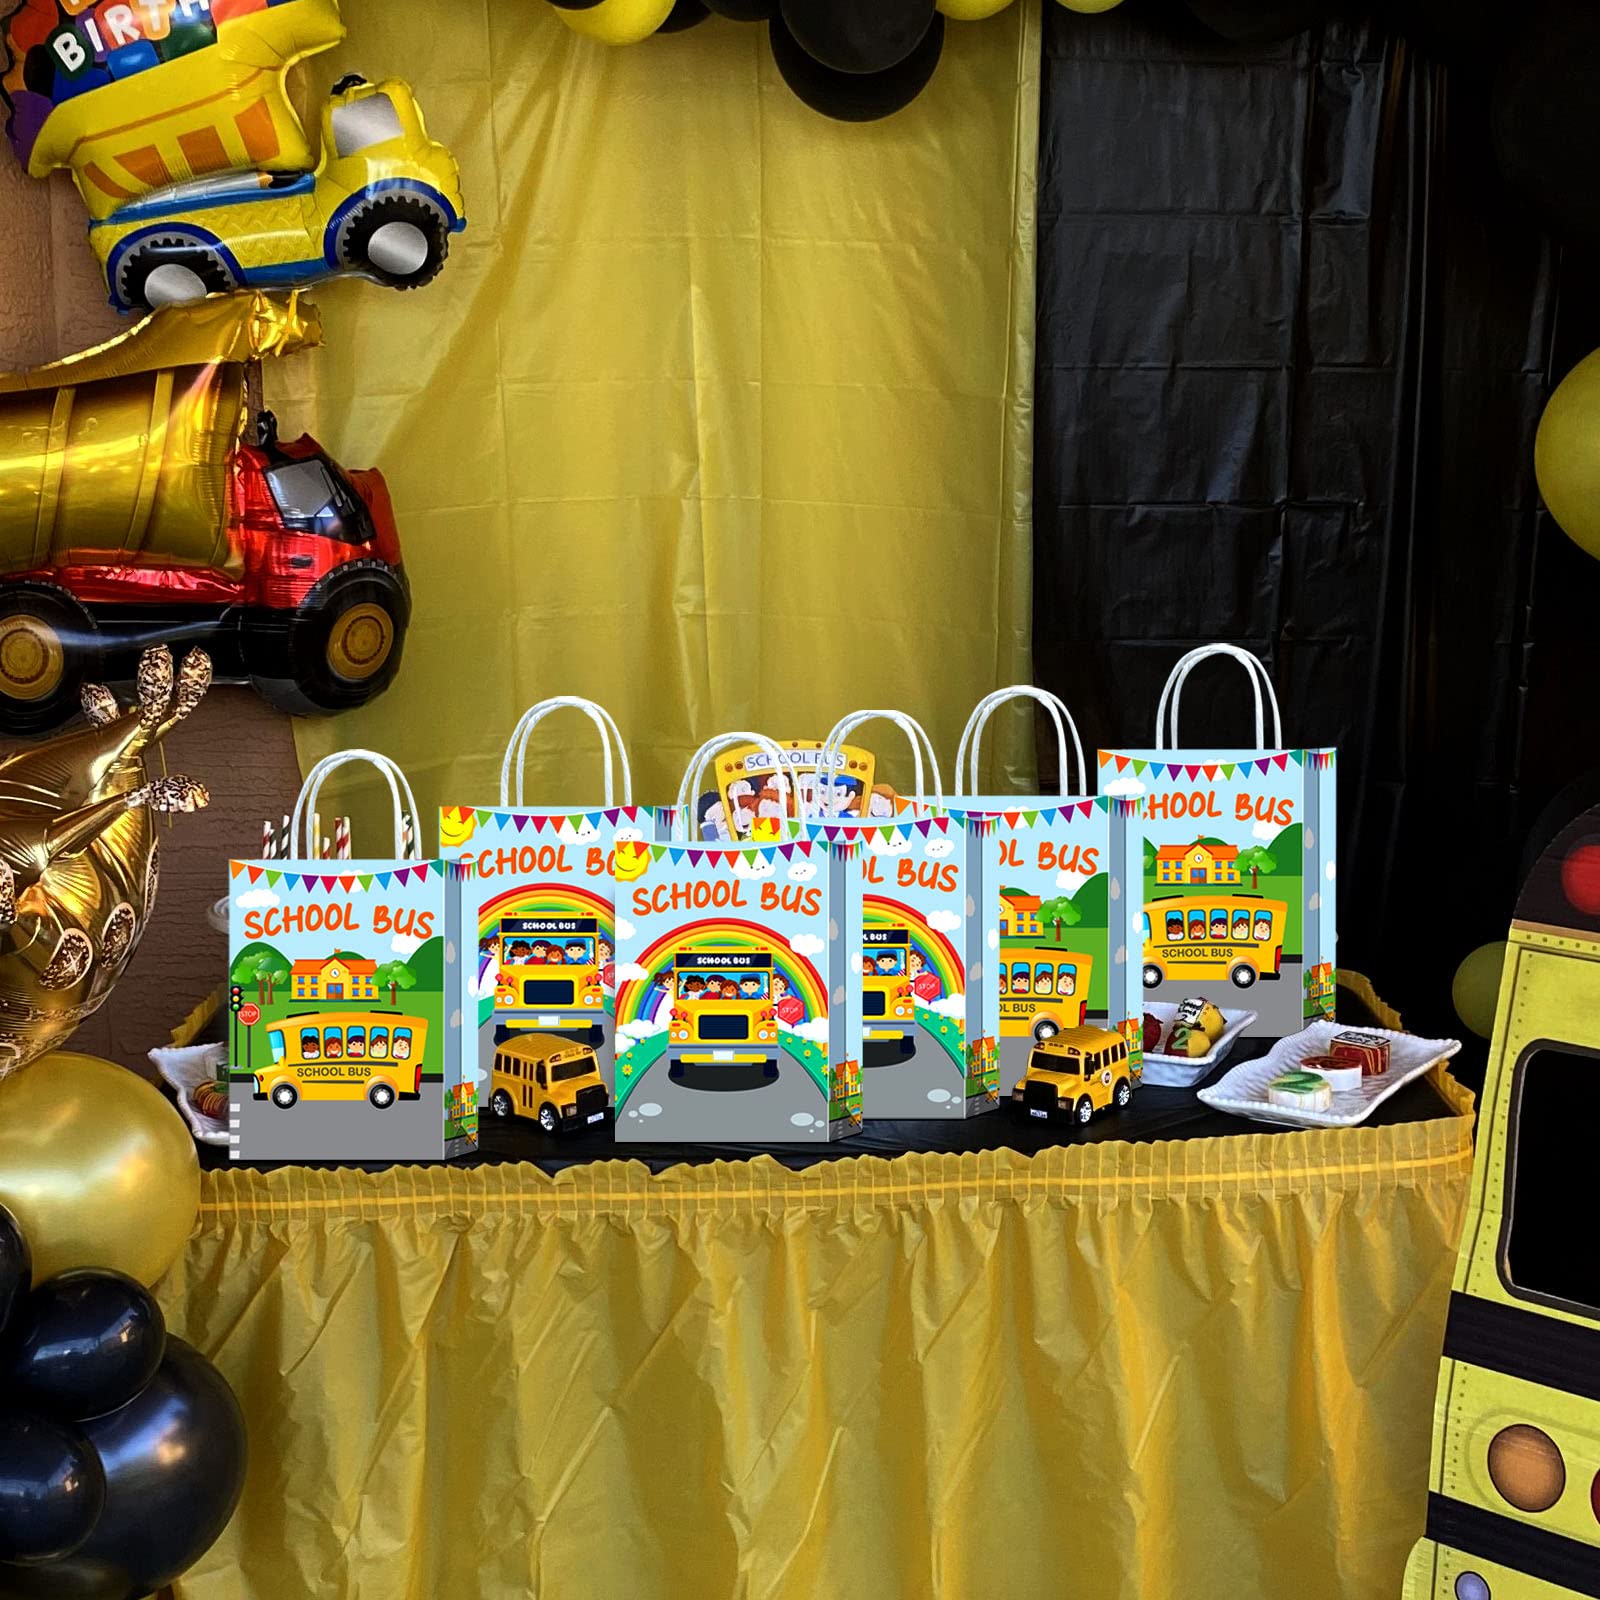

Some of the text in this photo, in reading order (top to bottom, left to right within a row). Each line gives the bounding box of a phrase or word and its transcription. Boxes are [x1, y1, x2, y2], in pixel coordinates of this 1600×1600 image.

[1235, 793, 1294, 826] BUS
[1038, 842, 1099, 876] BUS
[897, 859, 959, 892] BUS
[632, 880, 822, 916] SCHOOL BUS
[244, 903, 435, 939] SCHOOL BUS
[522, 922, 576, 930] SCHOOL BUS
[870, 933, 887, 941] BUS
[697, 957, 751, 965] SCHOOL BUS
[1162, 949, 1233, 958] SCHOOL BUS
[1013, 1003, 1036, 1013] BUS
[1171, 1027, 1191, 1050] 2
[297, 1067, 372, 1077] SCHOOL BUS
